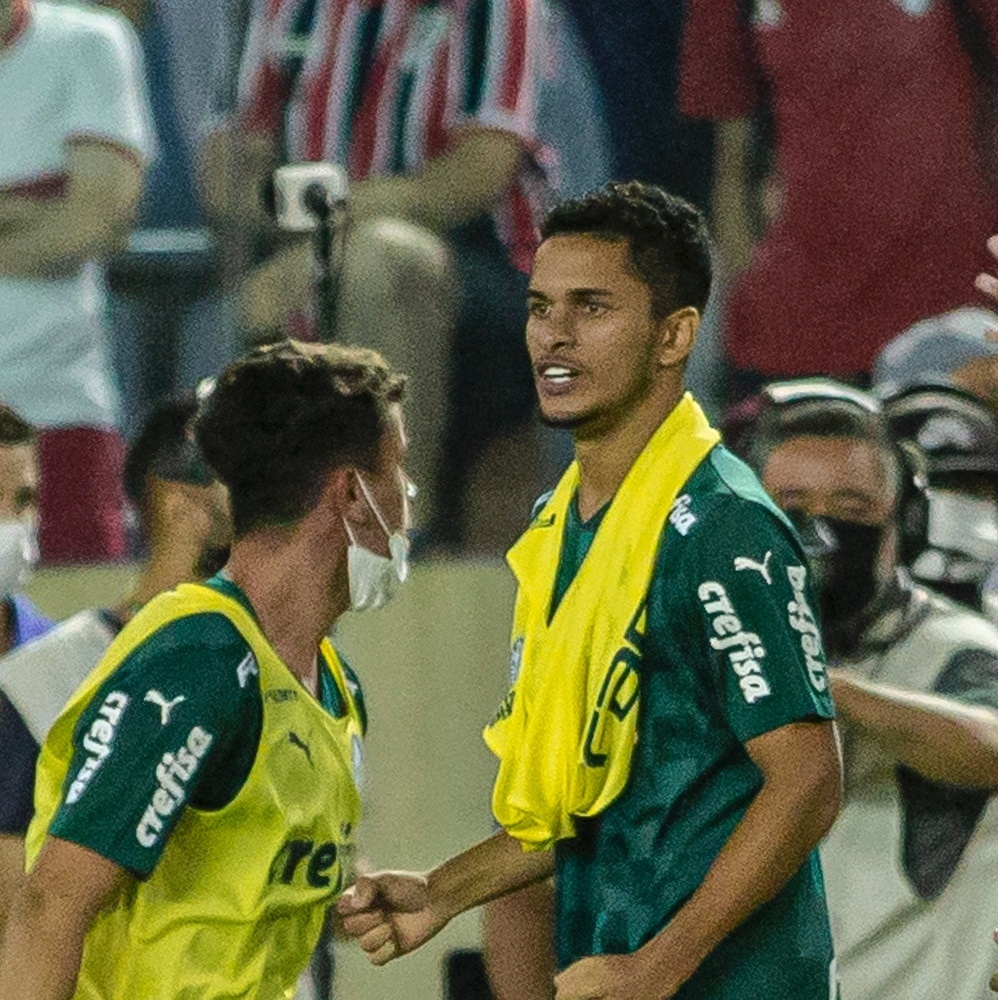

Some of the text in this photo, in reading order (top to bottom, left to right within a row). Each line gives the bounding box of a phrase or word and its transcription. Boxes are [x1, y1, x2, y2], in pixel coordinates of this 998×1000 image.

[697, 581, 771, 703] crefisa
[787, 565, 826, 692] crefisa
[136, 726, 213, 848] crefisa
